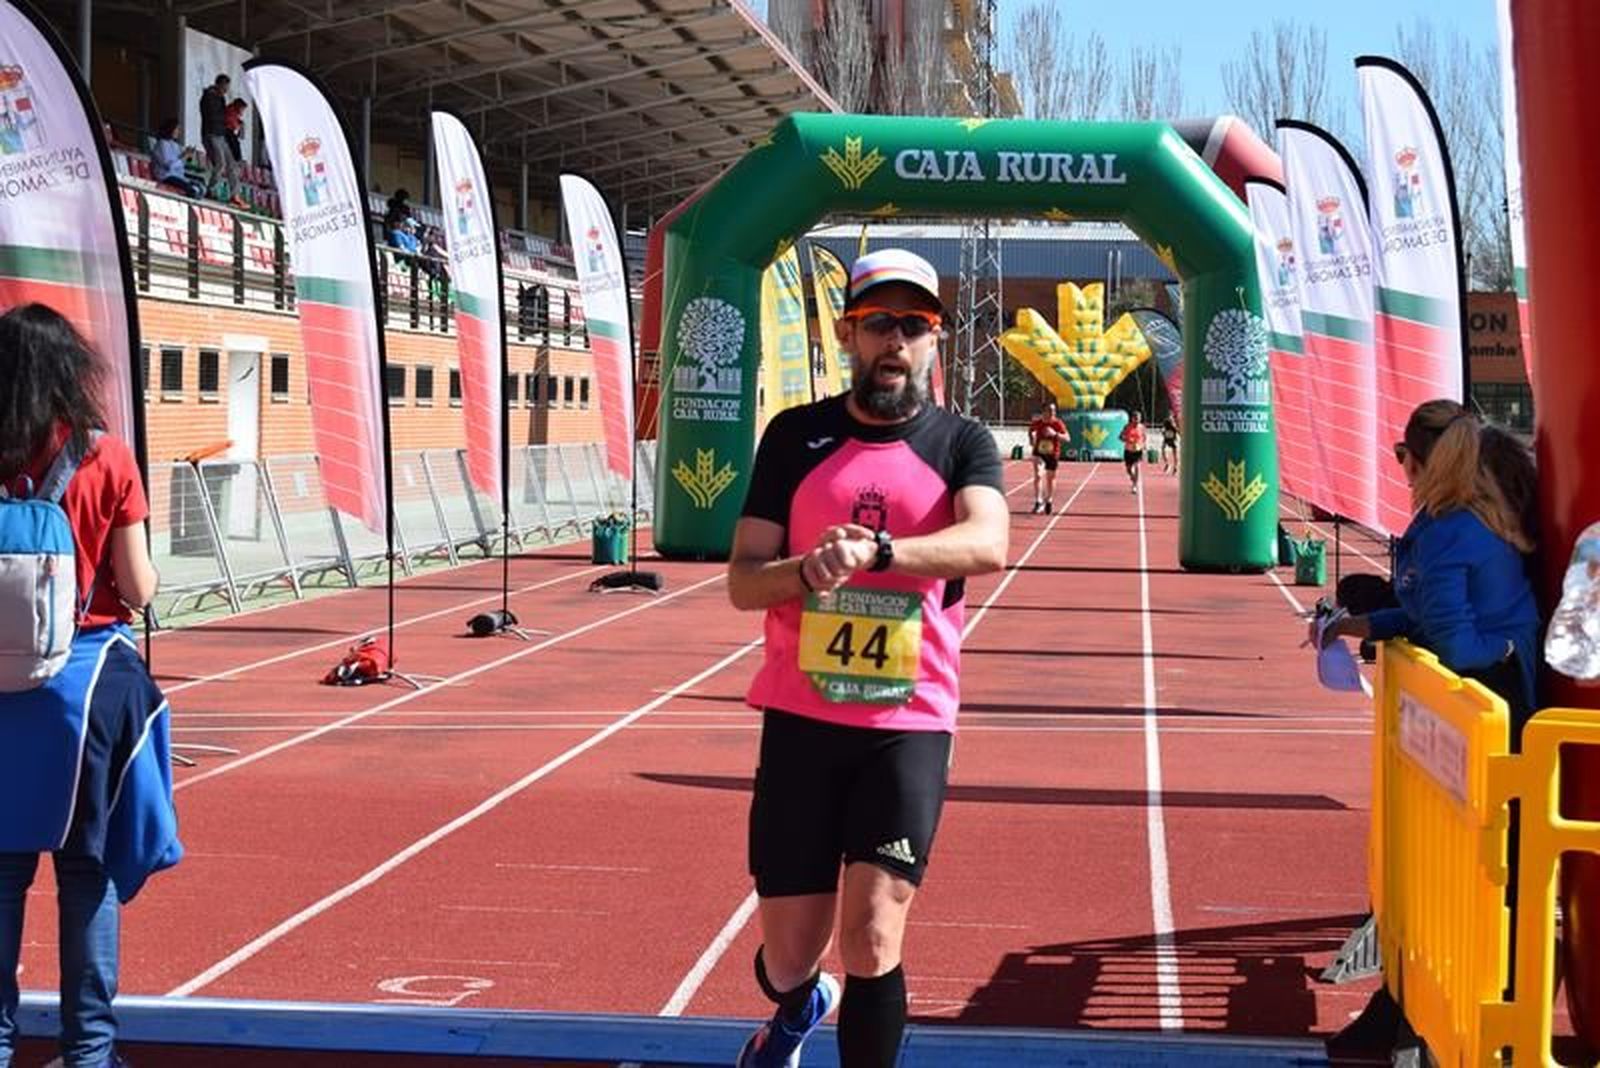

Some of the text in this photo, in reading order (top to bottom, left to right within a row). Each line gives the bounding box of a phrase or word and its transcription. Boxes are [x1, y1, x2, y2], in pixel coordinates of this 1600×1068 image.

[895, 149, 1127, 184] CAJA RURAL
[673, 397, 741, 409] FUNDACION
[673, 408, 700, 420] CAJA
[1202, 409, 1269, 421] FUNDACION
[1201, 421, 1230, 433] CAJA
[826, 621, 890, 670] 44
